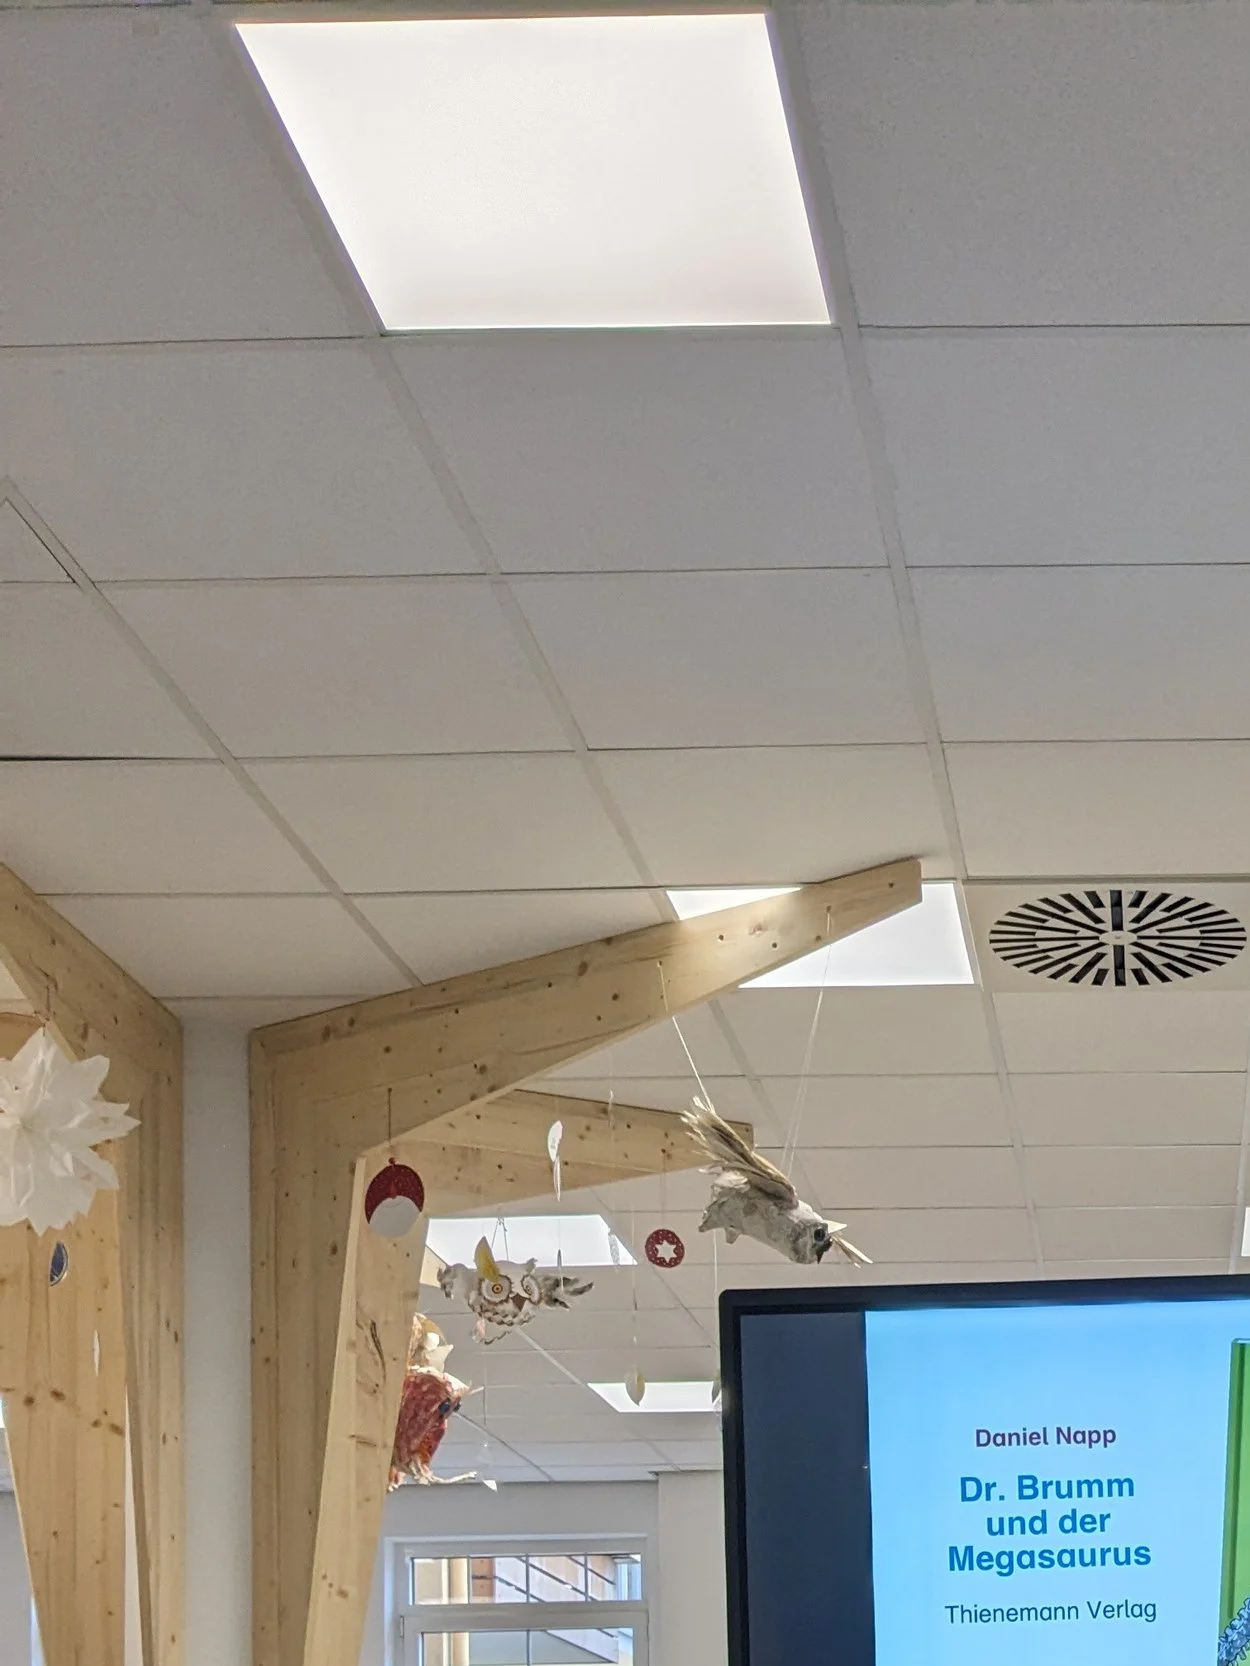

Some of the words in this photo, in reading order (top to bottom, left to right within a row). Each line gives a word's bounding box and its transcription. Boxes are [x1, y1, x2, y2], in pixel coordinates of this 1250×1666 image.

[975, 1427, 1049, 1448] Daniel
[1056, 1426, 1117, 1449] Napp
[960, 1476, 1006, 1502] Dr.
[1017, 1475, 1135, 1501] Brumm
[986, 1509, 1048, 1536] und
[1058, 1508, 1111, 1534] der
[948, 1545, 1151, 1577] Megasaurus
[944, 1603, 1079, 1624] Thienemann
[1086, 1599, 1157, 1622] Verlag
